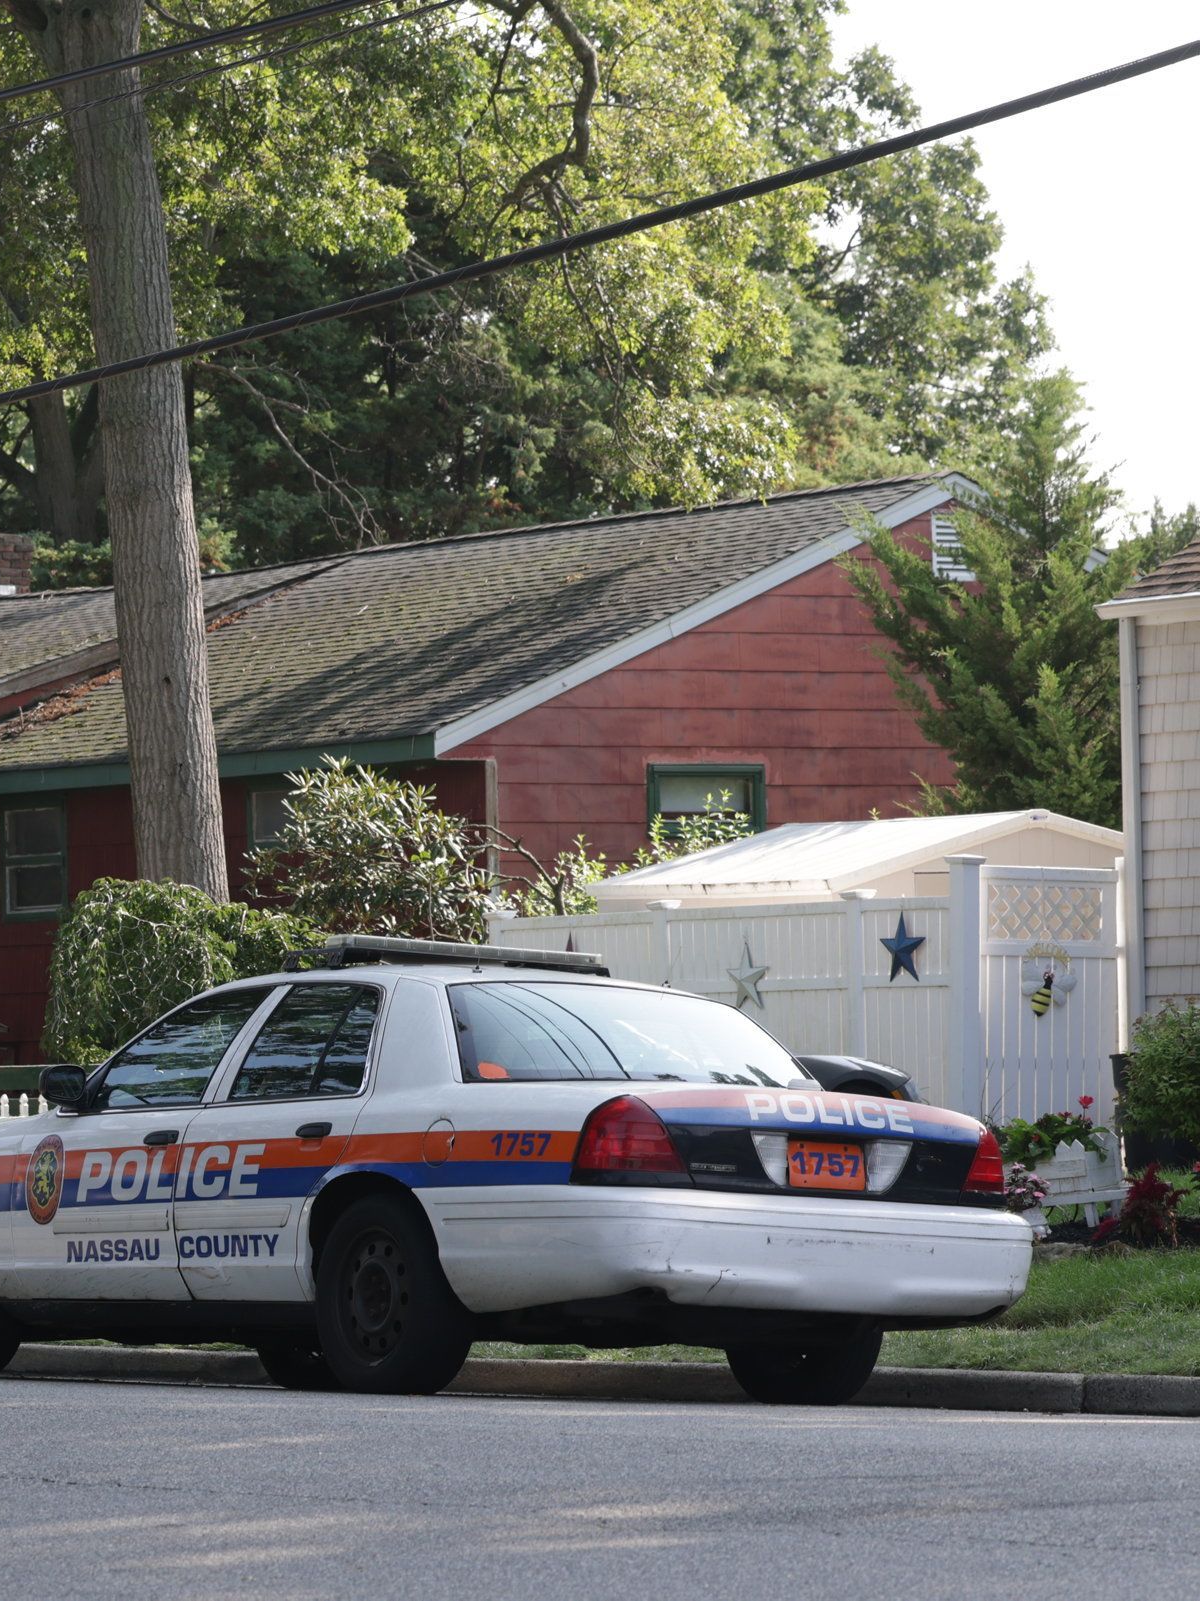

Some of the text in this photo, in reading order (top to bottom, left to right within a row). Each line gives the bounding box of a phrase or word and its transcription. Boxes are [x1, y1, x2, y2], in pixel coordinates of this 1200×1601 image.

[744, 1093, 914, 1134] POLICE
[490, 1133, 551, 1156] 1757
[76, 1143, 266, 1202] POLICE
[791, 1151, 860, 1177] 1757
[66, 1234, 280, 1263] NASSAU COUNTY
